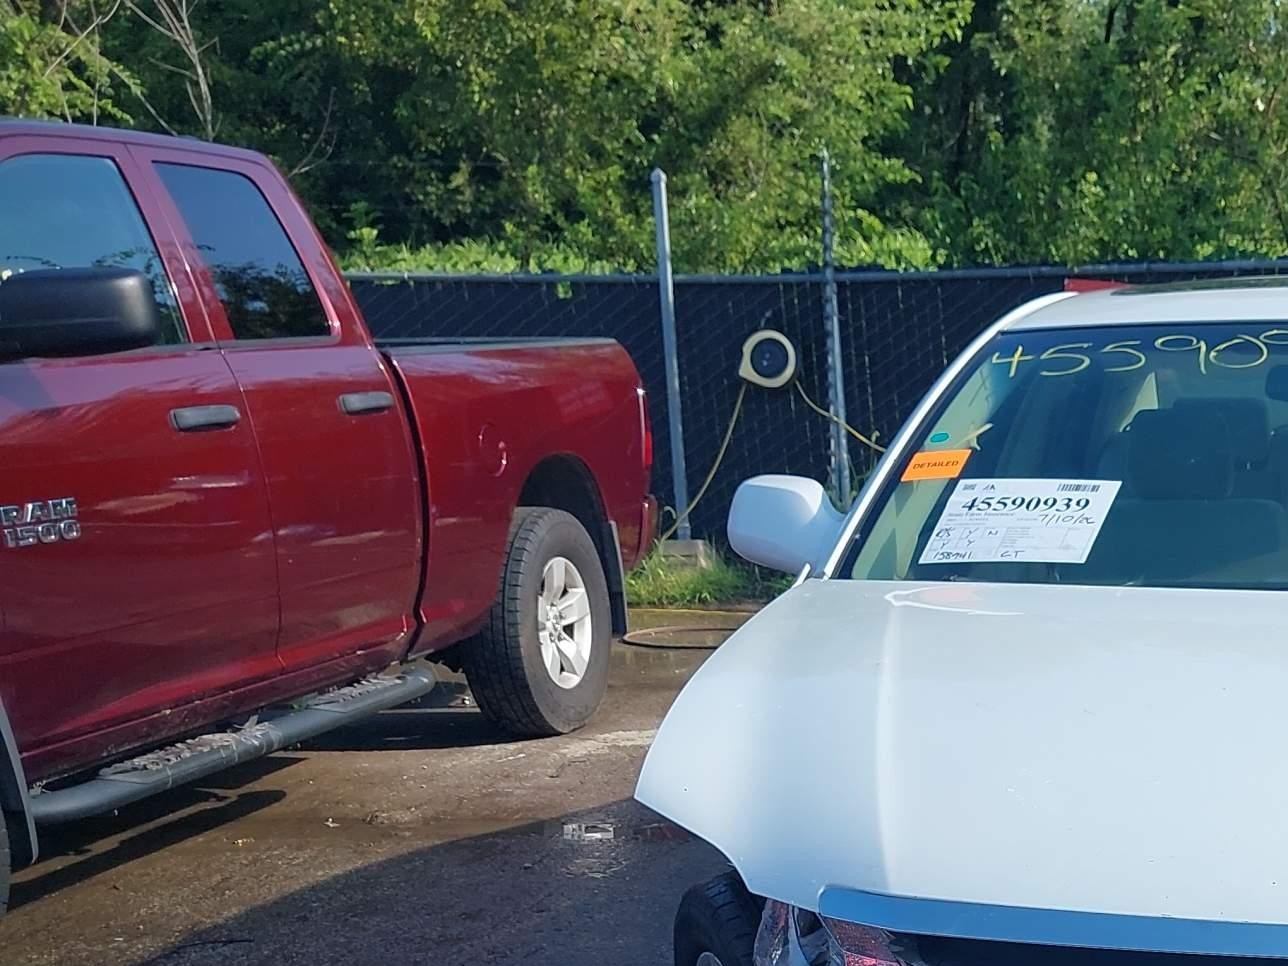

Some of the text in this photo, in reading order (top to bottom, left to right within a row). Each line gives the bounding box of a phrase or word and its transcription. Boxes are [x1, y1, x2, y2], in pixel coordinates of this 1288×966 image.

[912, 460, 959, 470] DETAILED
[0, 497, 78, 526] RAM
[961, 496, 1091, 512] 45590939
[3, 520, 81, 548] 1500
